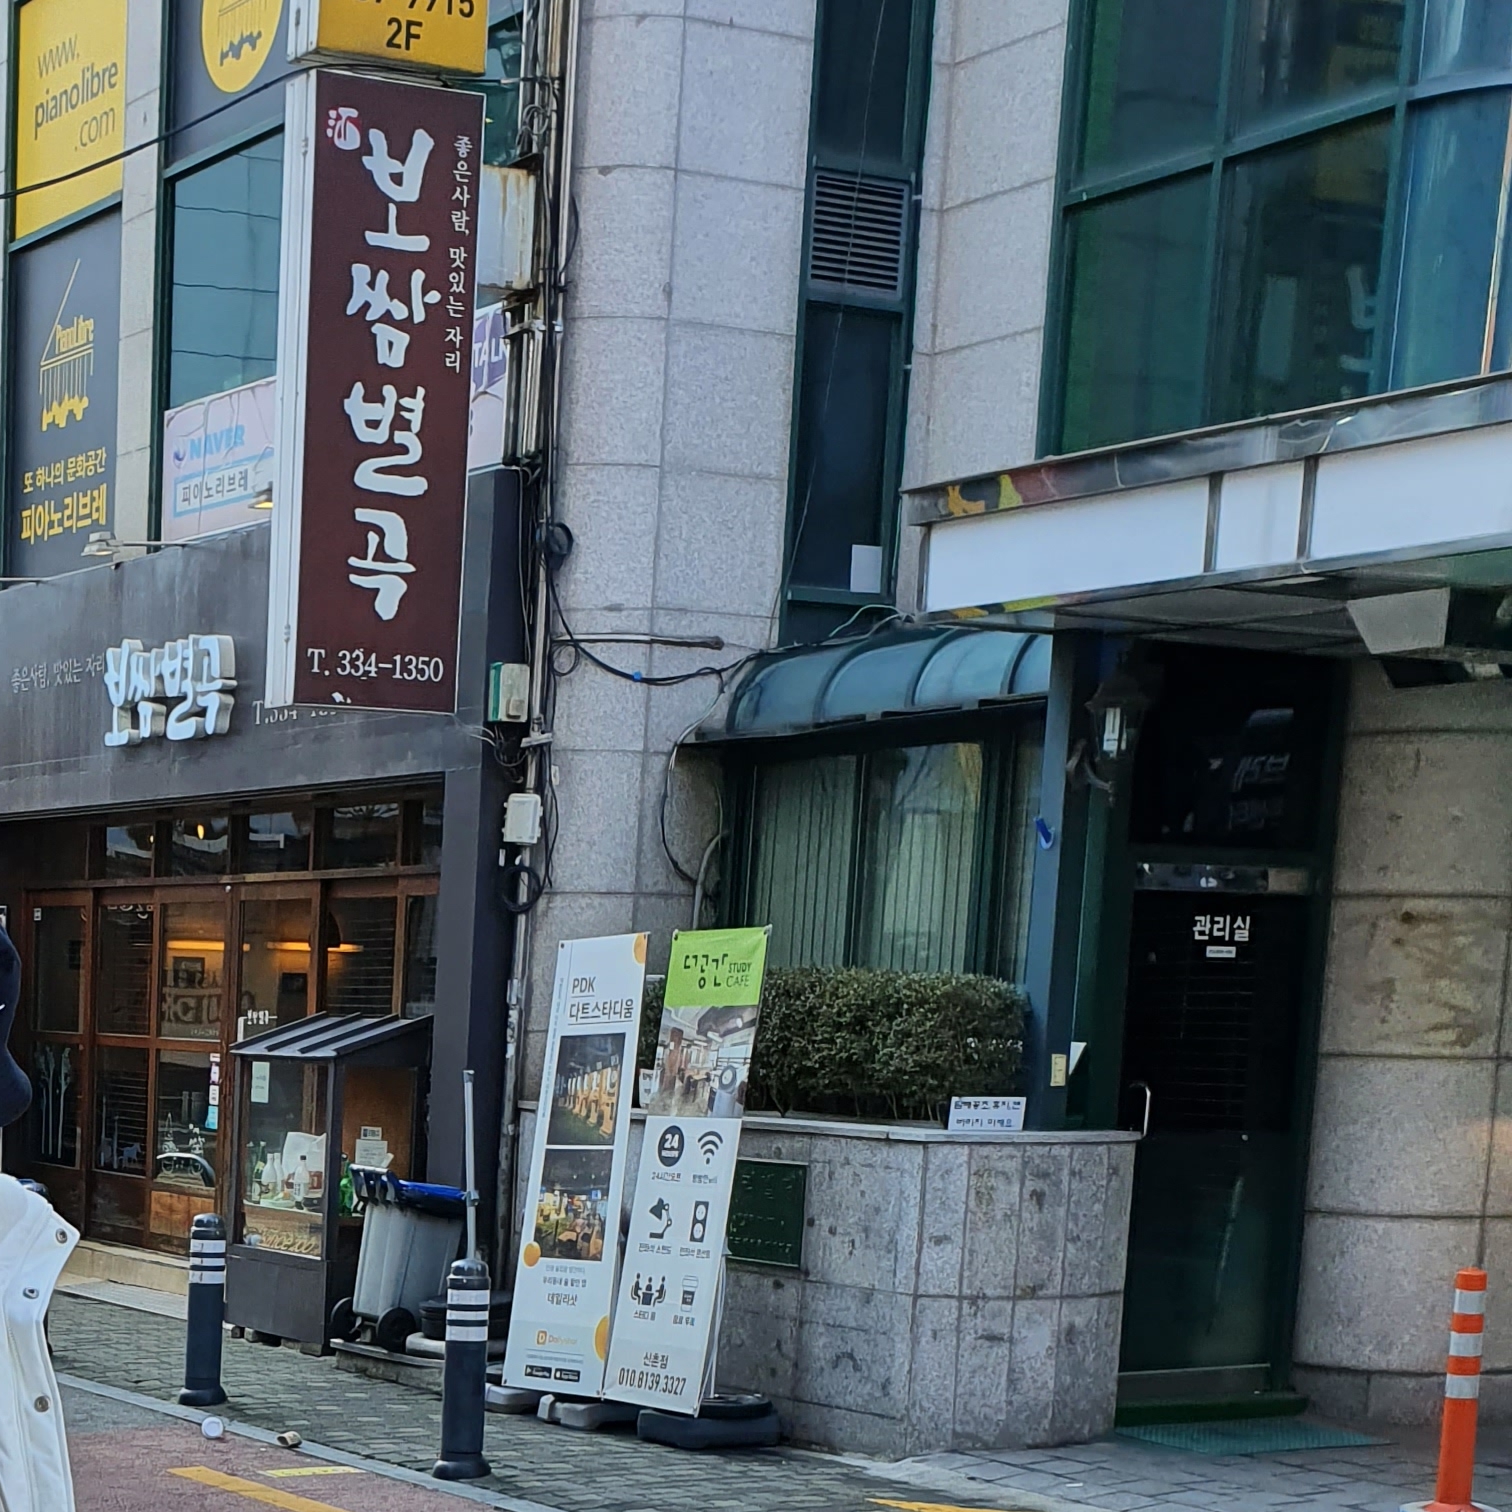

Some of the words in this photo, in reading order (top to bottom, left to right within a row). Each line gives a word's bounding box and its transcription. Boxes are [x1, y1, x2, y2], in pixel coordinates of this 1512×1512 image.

[385, 16, 424, 51] 2F
[37, 34, 80, 78] www.
[34, 61, 119, 141] pianolibre
[74, 107, 115, 152] .com
[451, 134, 474, 236] 좋은사람,
[444, 246, 468, 318] 맛있는
[444, 326, 465, 374] 자리
[343, 127, 442, 621] 보쌈별곡
[189, 424, 246, 460] NAVER
[23, 471, 34, 494] 또
[35, 459, 64, 491] 하나의
[66, 446, 107, 482] 문화공간
[180, 468, 248, 507] 피아노리브레
[20, 483, 108, 545] 피아노리브레
[53, 657, 84, 686] 맛있는
[307, 648, 331, 676] T.
[336, 649, 444, 682] 334-1350
[1192, 914, 1251, 942] 관리실
[571, 976, 597, 994] PDK
[726, 975, 750, 987] CAFE
[728, 962, 752, 974] STUDY
[569, 998, 634, 1022] 다트스타디움
[663, 1133, 679, 1149] 24
[643, 1352, 669, 1370] 신촌점
[618, 1367, 687, 1397] 010.8139.3327
